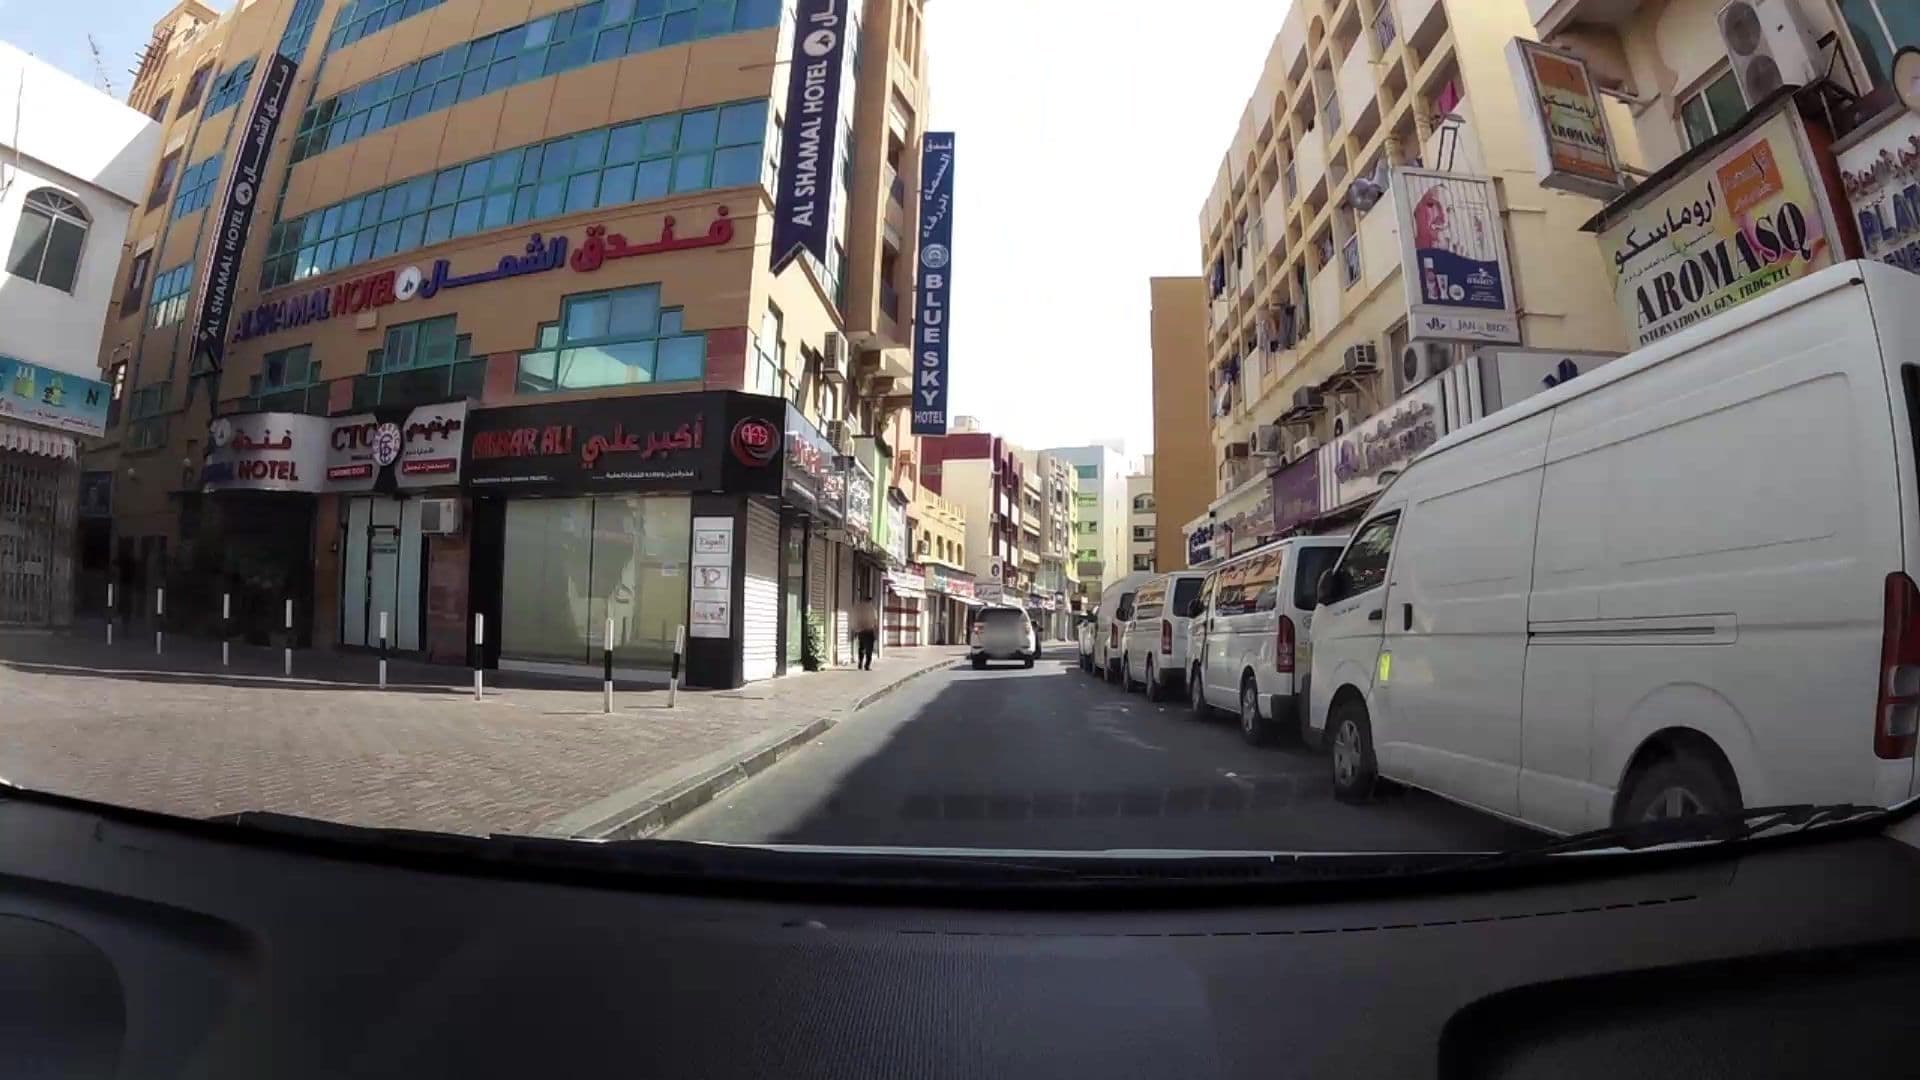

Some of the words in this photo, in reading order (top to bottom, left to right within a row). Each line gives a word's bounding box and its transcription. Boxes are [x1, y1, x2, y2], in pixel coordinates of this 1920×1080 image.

[264, 64, 290, 118] فندق
[802, 60, 828, 113] HOTEL
[243, 116, 272, 183] الشمال
[794, 117, 822, 197] SHAMAL
[224, 209, 245, 251] HOTEL
[569, 204, 735, 273] فندق
[792, 201, 815, 227] AL
[1614, 180, 1717, 274] اروماسكو
[211, 255, 236, 315] SHAMAL
[420, 231, 568, 298] الشمال
[1636, 201, 1813, 330] AROMASQ
[331, 269, 396, 318] HOTEL
[922, 273, 944, 343] BLUE
[208, 319, 222, 338] AL
[1639, 304, 1712, 346] INTERNATIONAL
[920, 351, 941, 407] SKY
[541, 424, 576, 455] ALI
[914, 410, 945, 425] HOTEL
[237, 460, 299, 481] HOTEL
[581, 423, 641, 470] علي
